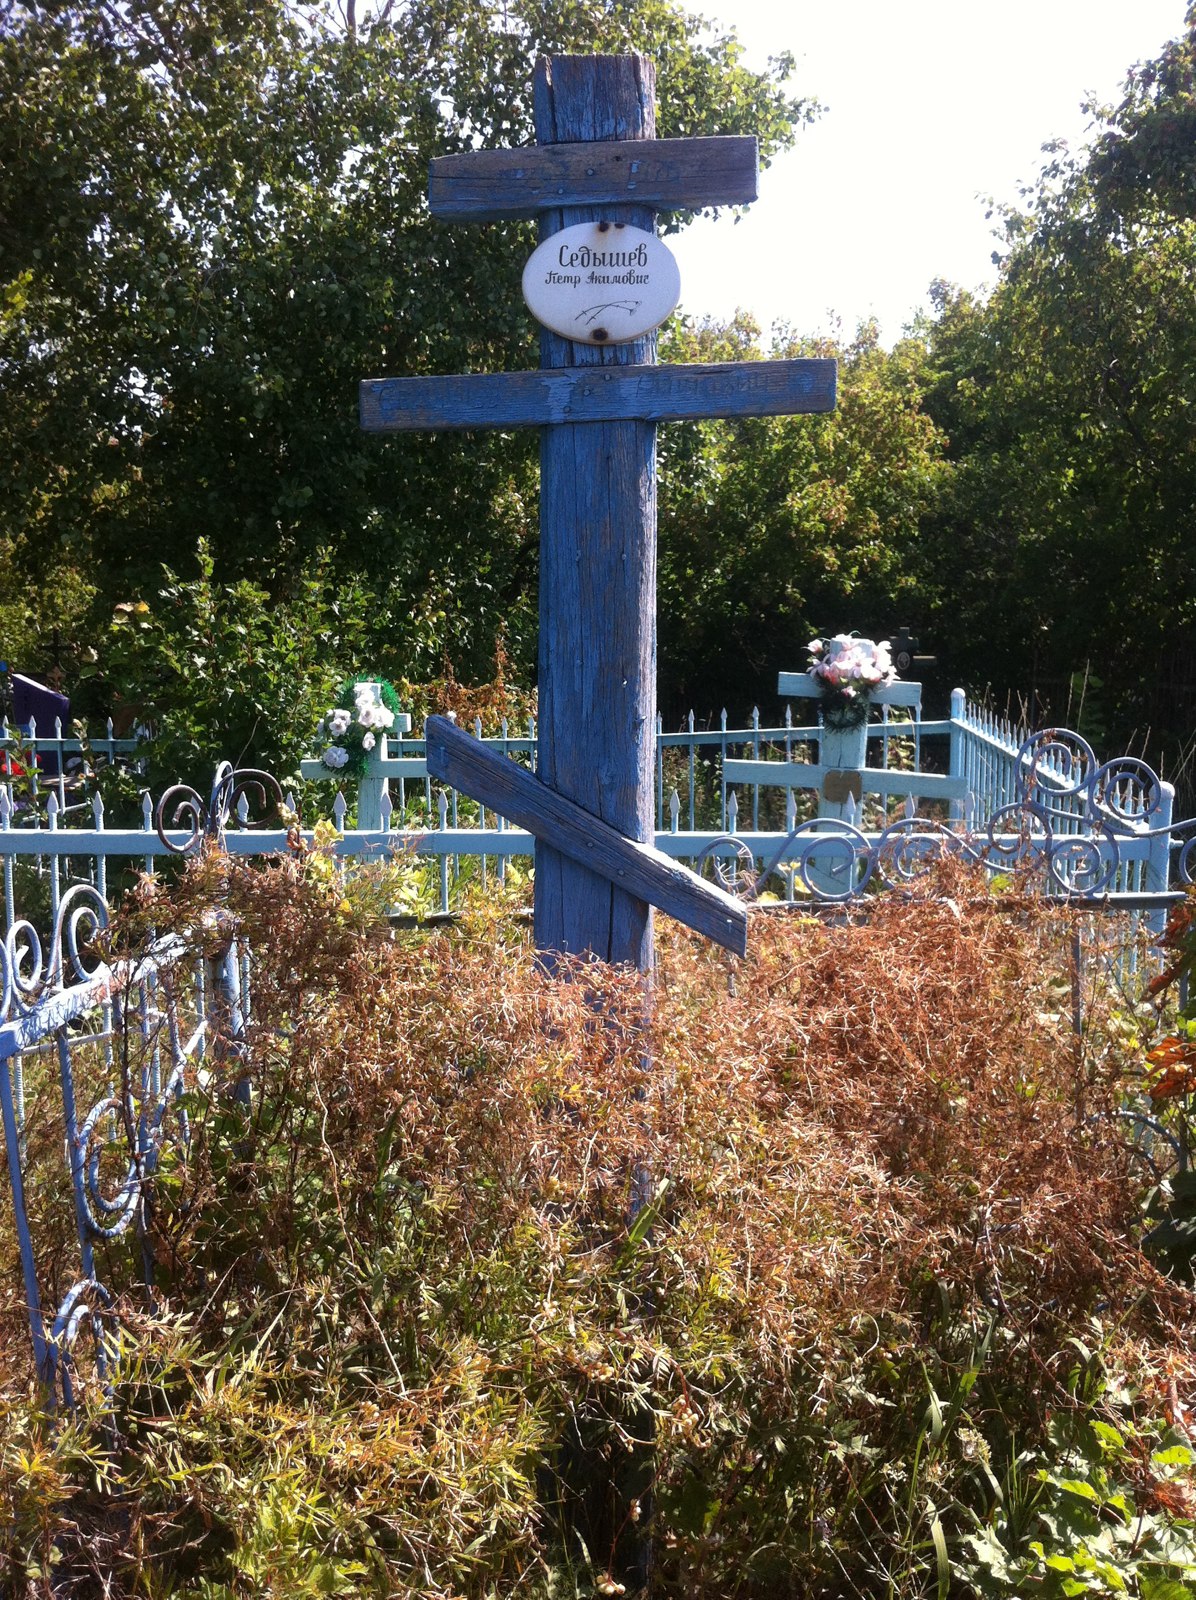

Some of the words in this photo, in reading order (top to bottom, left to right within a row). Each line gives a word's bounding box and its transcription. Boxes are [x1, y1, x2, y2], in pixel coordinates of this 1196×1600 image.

[559, 243, 648, 268] Седышев
[545, 271, 581, 288] Петр
[585, 269, 649, 285] Акимович
